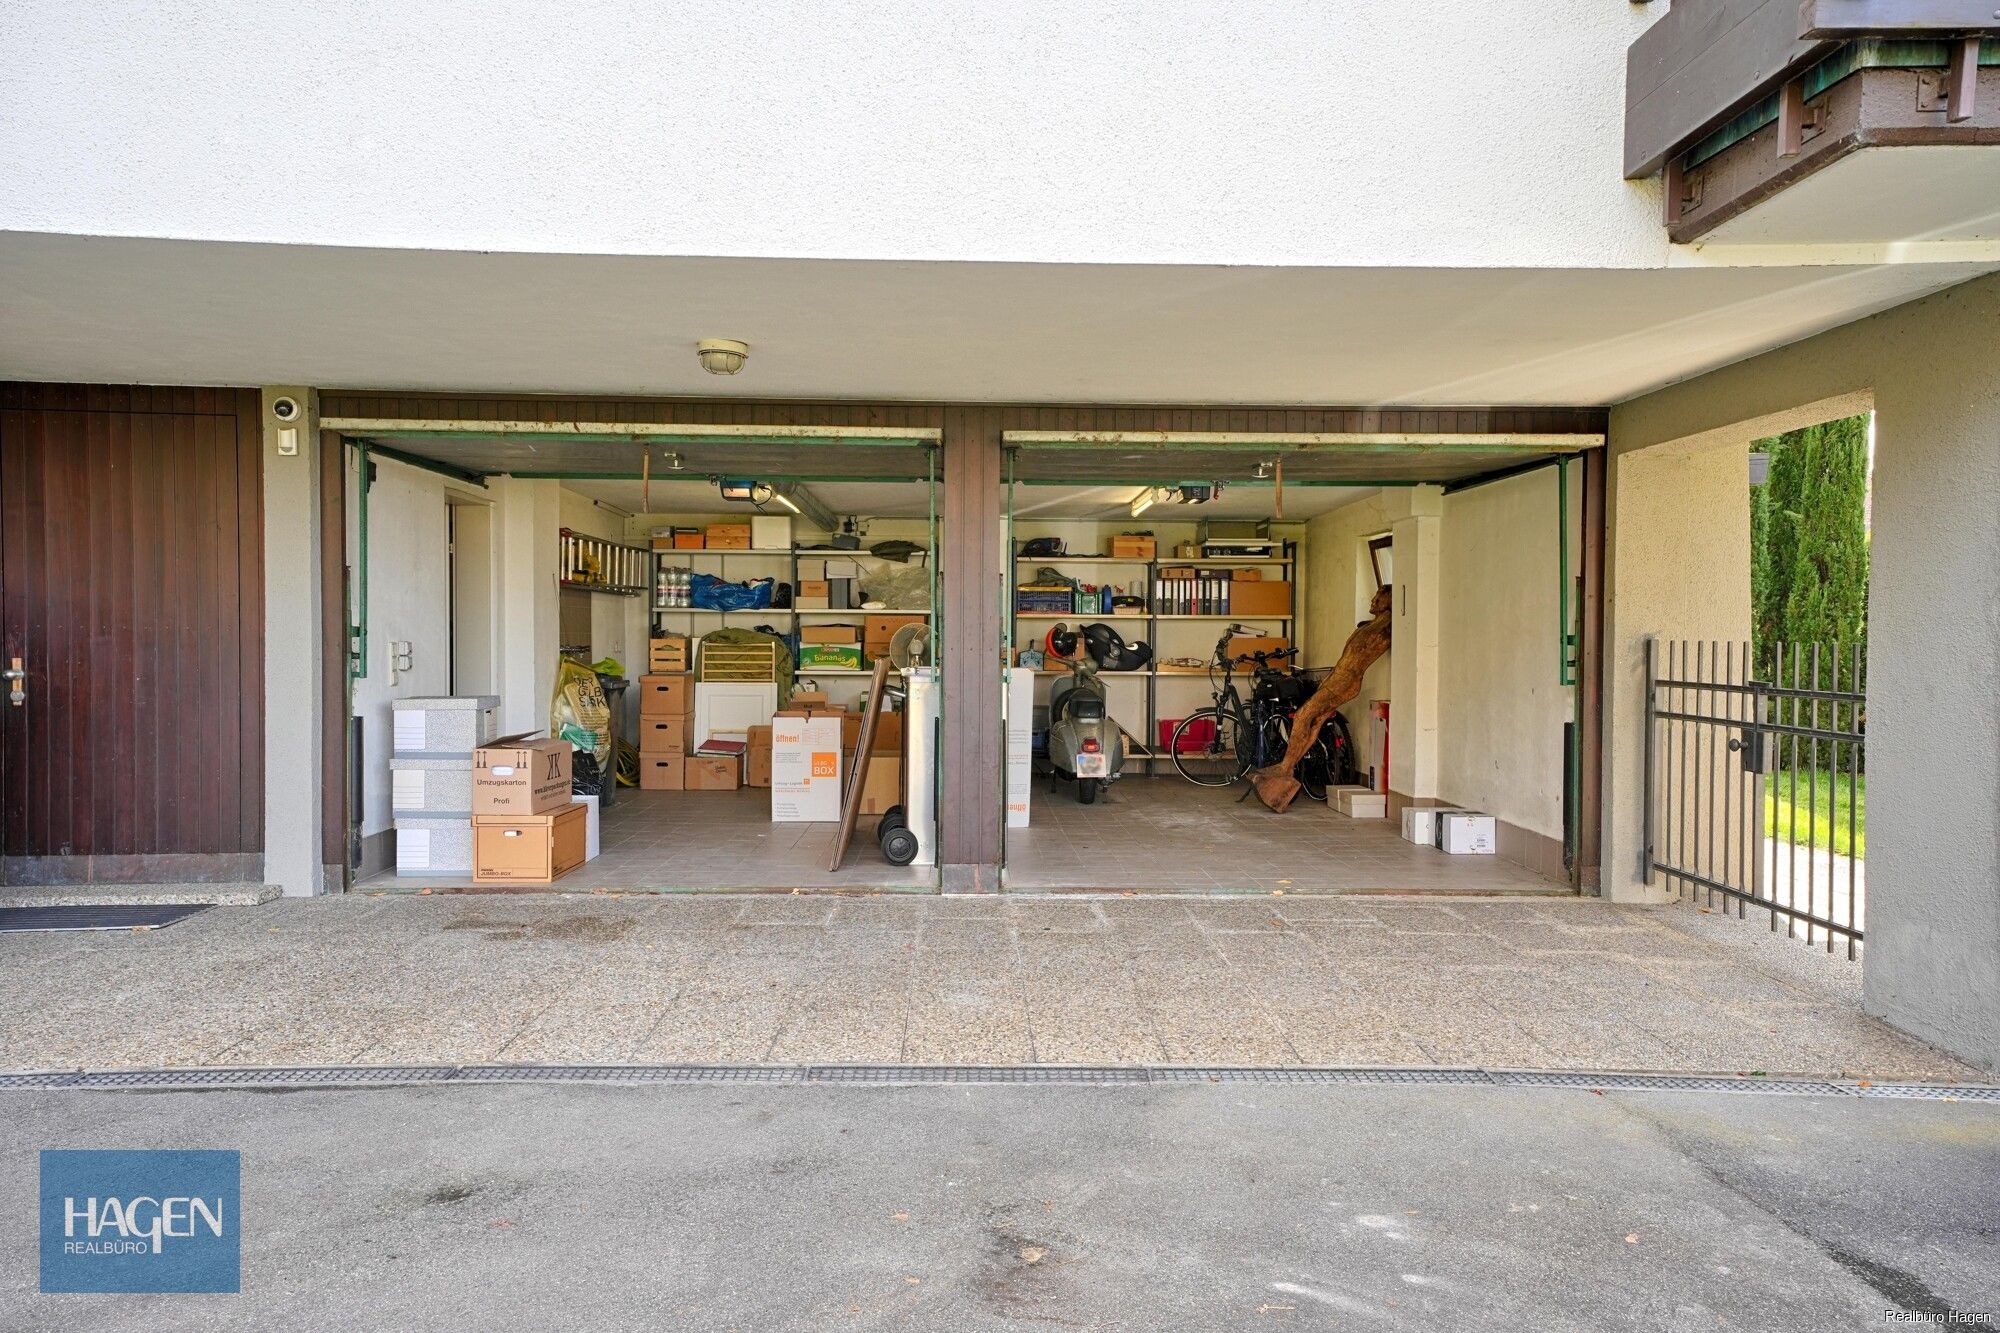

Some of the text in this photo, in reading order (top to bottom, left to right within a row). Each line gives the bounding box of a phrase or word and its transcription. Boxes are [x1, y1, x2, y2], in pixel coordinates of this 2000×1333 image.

[814, 654, 846, 662] bananas
[775, 733, 800, 743] öffnen!
[814, 766, 834, 775] BOX
[476, 779, 527, 787] Umzugskarton
